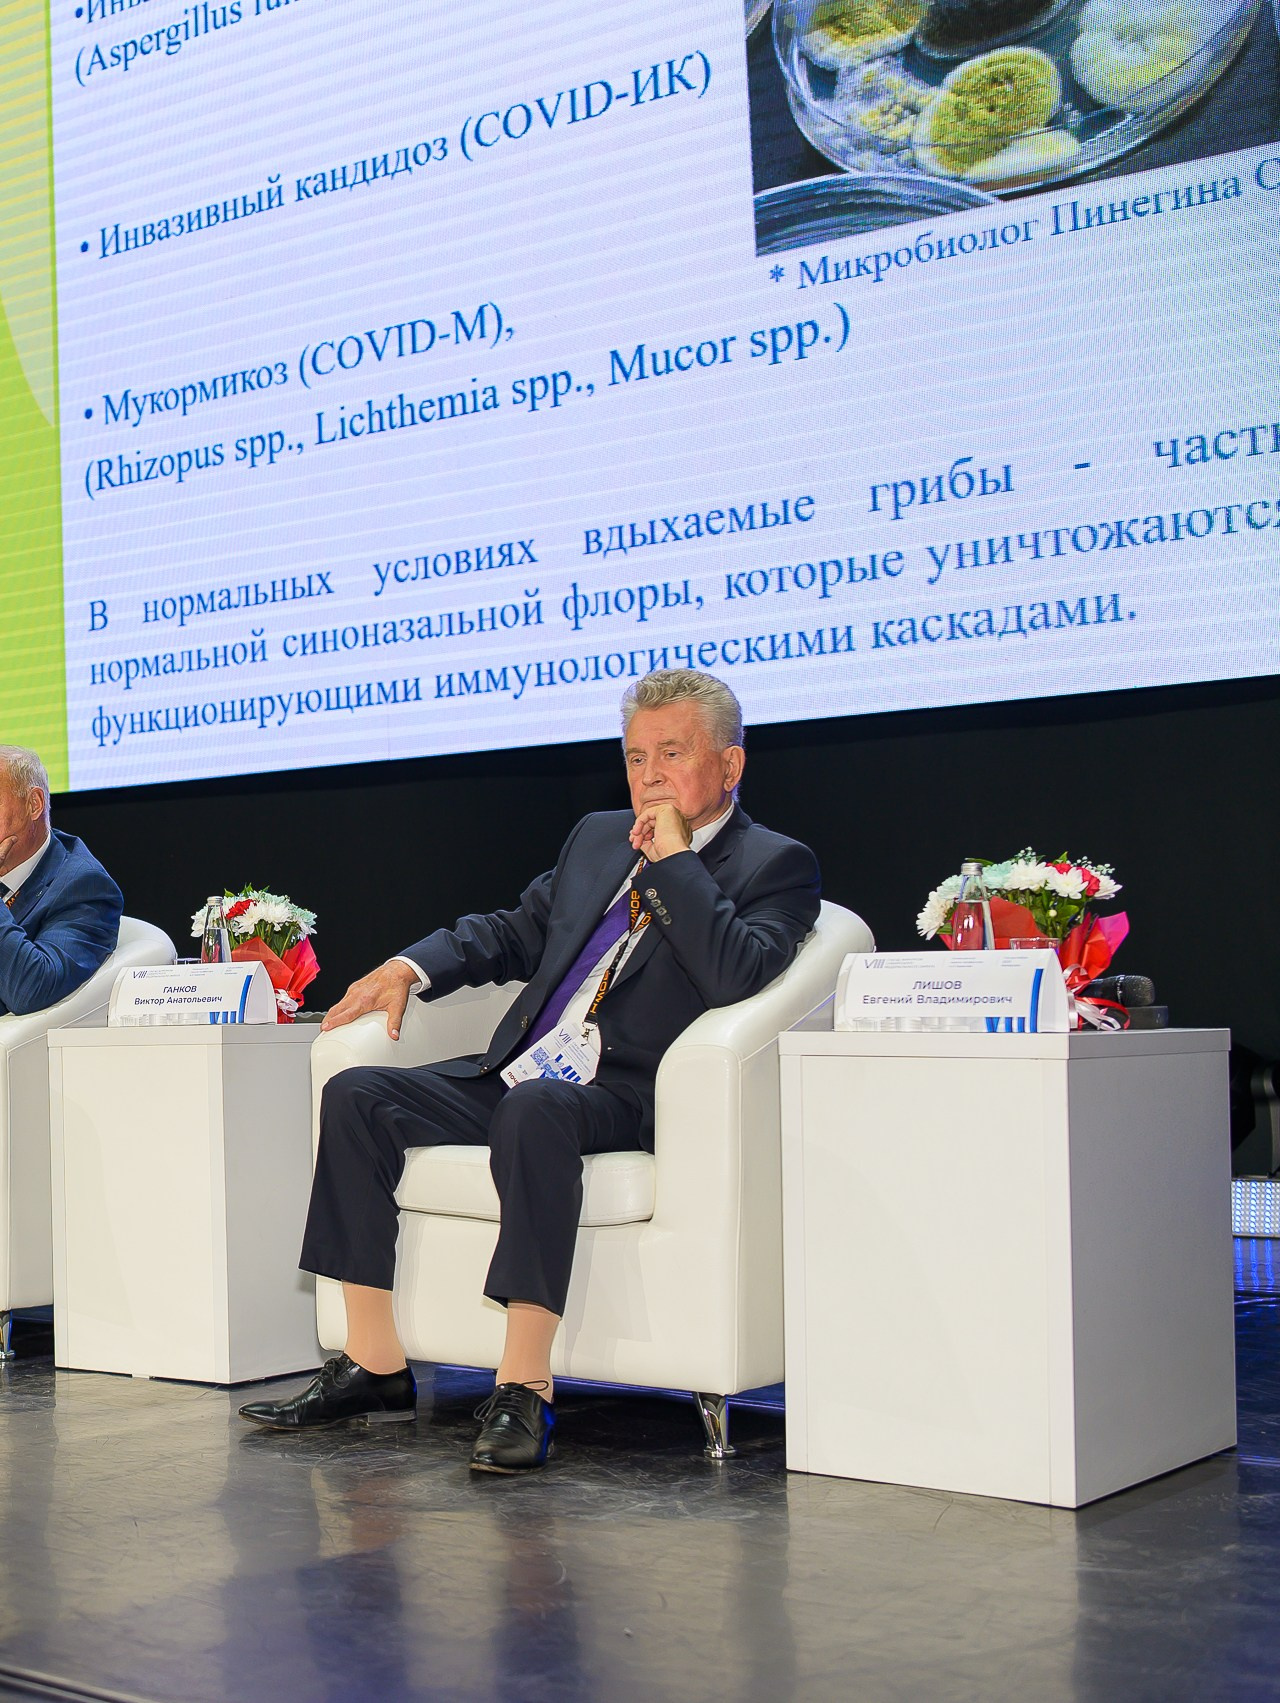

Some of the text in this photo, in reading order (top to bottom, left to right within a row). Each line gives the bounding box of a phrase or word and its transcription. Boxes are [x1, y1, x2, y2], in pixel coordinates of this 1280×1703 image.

[76, 0, 242, 87] (Aspergillus
[98, 50, 713, 259] Инвазивный кандидоз (COVID-ИК)
[797, 220, 1039, 290] Микробиолог
[1051, 176, 1241, 236] Пинегина
[84, 302, 851, 500] (Rhizopus spp., Lichthemia spp., Mucor spp.)
[102, 301, 515, 427] Мукормикоз (COVID-M),
[90, 599, 108, 632] В
[143, 571, 334, 629] нормальных
[373, 538, 538, 596] условиях
[583, 495, 816, 558] вдыхаемые
[868, 457, 1014, 520] грибы
[91, 629, 268, 691] нормальной
[283, 588, 544, 658] синоназальной
[562, 583, 704, 631] флоры,
[724, 550, 904, 599] которые
[91, 593, 1137, 747] функционирующими иммунологическими каскадами.
[134, 996, 223, 1006] Виктор Анатольевич
[163, 985, 197, 994] ГАНКОВ
[863, 994, 1013, 1006] Евгений Владимирович
[912, 980, 962, 990] ЛИШОВ
